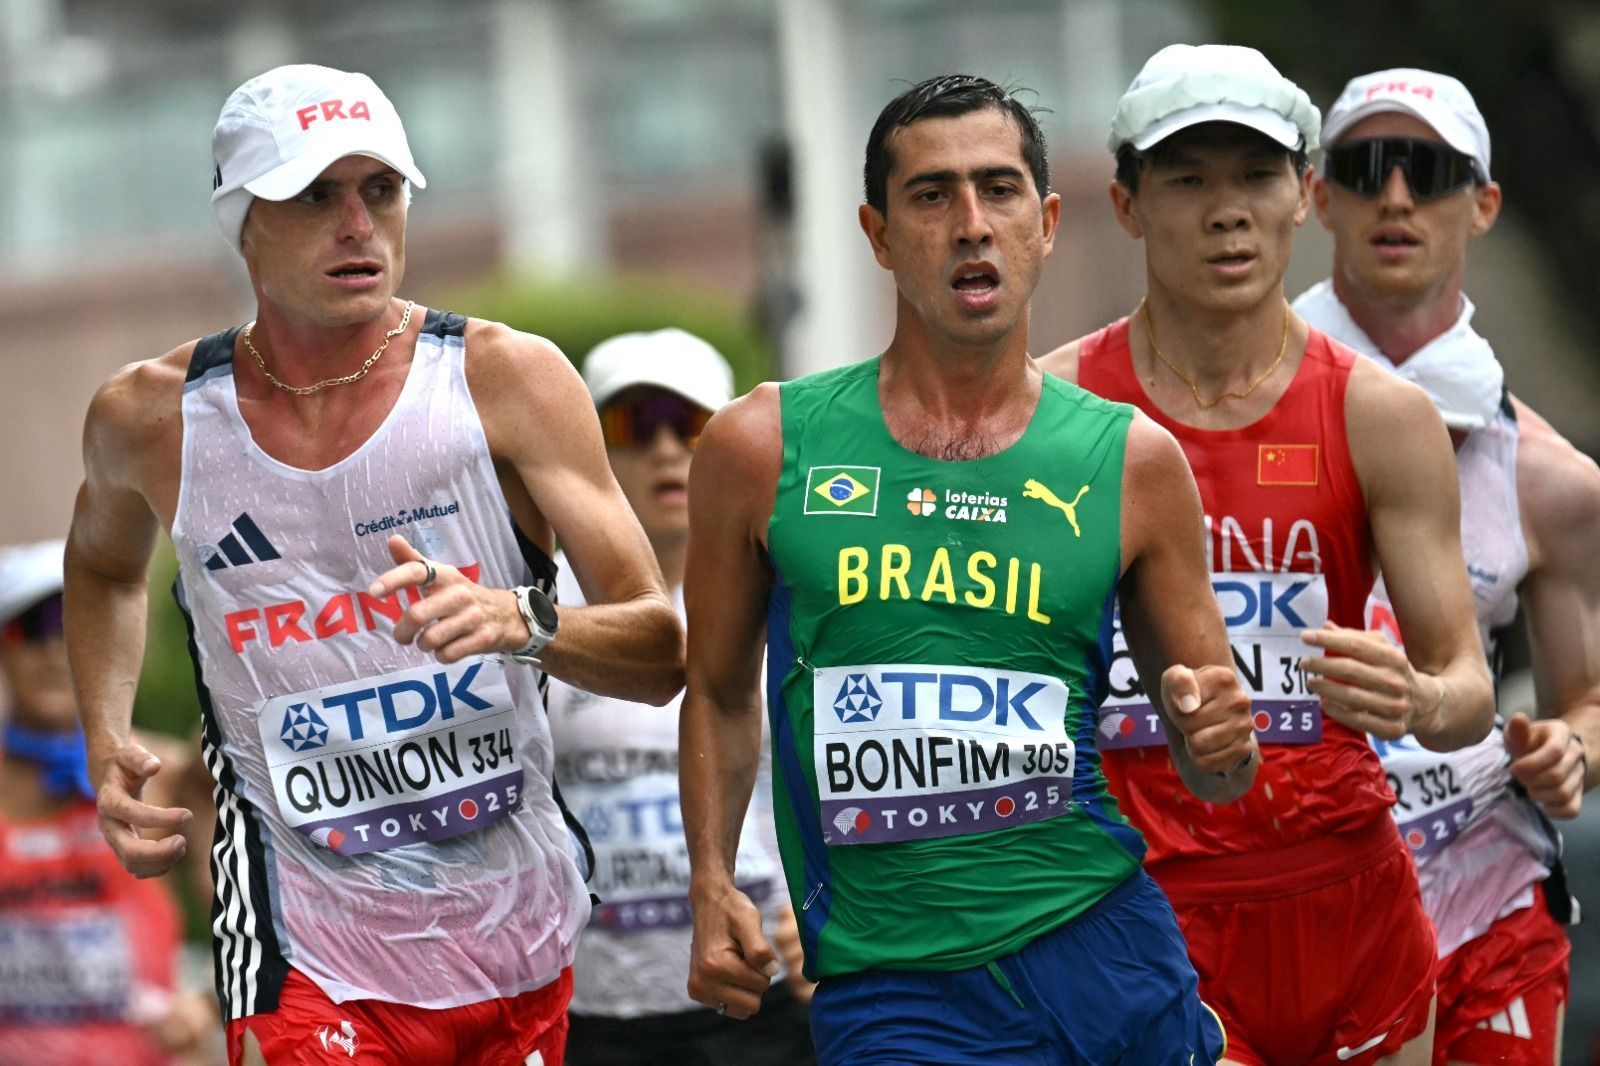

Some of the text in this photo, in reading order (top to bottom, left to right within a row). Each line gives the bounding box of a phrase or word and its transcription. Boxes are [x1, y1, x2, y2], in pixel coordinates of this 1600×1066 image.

[296, 99, 371, 130] FRA
[354, 501, 459, 538] Crédit Mutuel
[945, 489, 1008, 507] loterias
[945, 505, 1007, 523] CAIXA
[838, 544, 1051, 624] BRASIL
[1211, 580, 1310, 627] DK
[224, 562, 480, 654] FRAN
[322, 661, 494, 742] TDK
[881, 672, 1048, 731] TDK
[285, 727, 515, 814] QUINION 334
[826, 736, 1070, 793] BONFIM 305
[1411, 762, 1462, 807] 332
[484, 785, 518, 813] 25
[1024, 786, 1060, 812] 25
